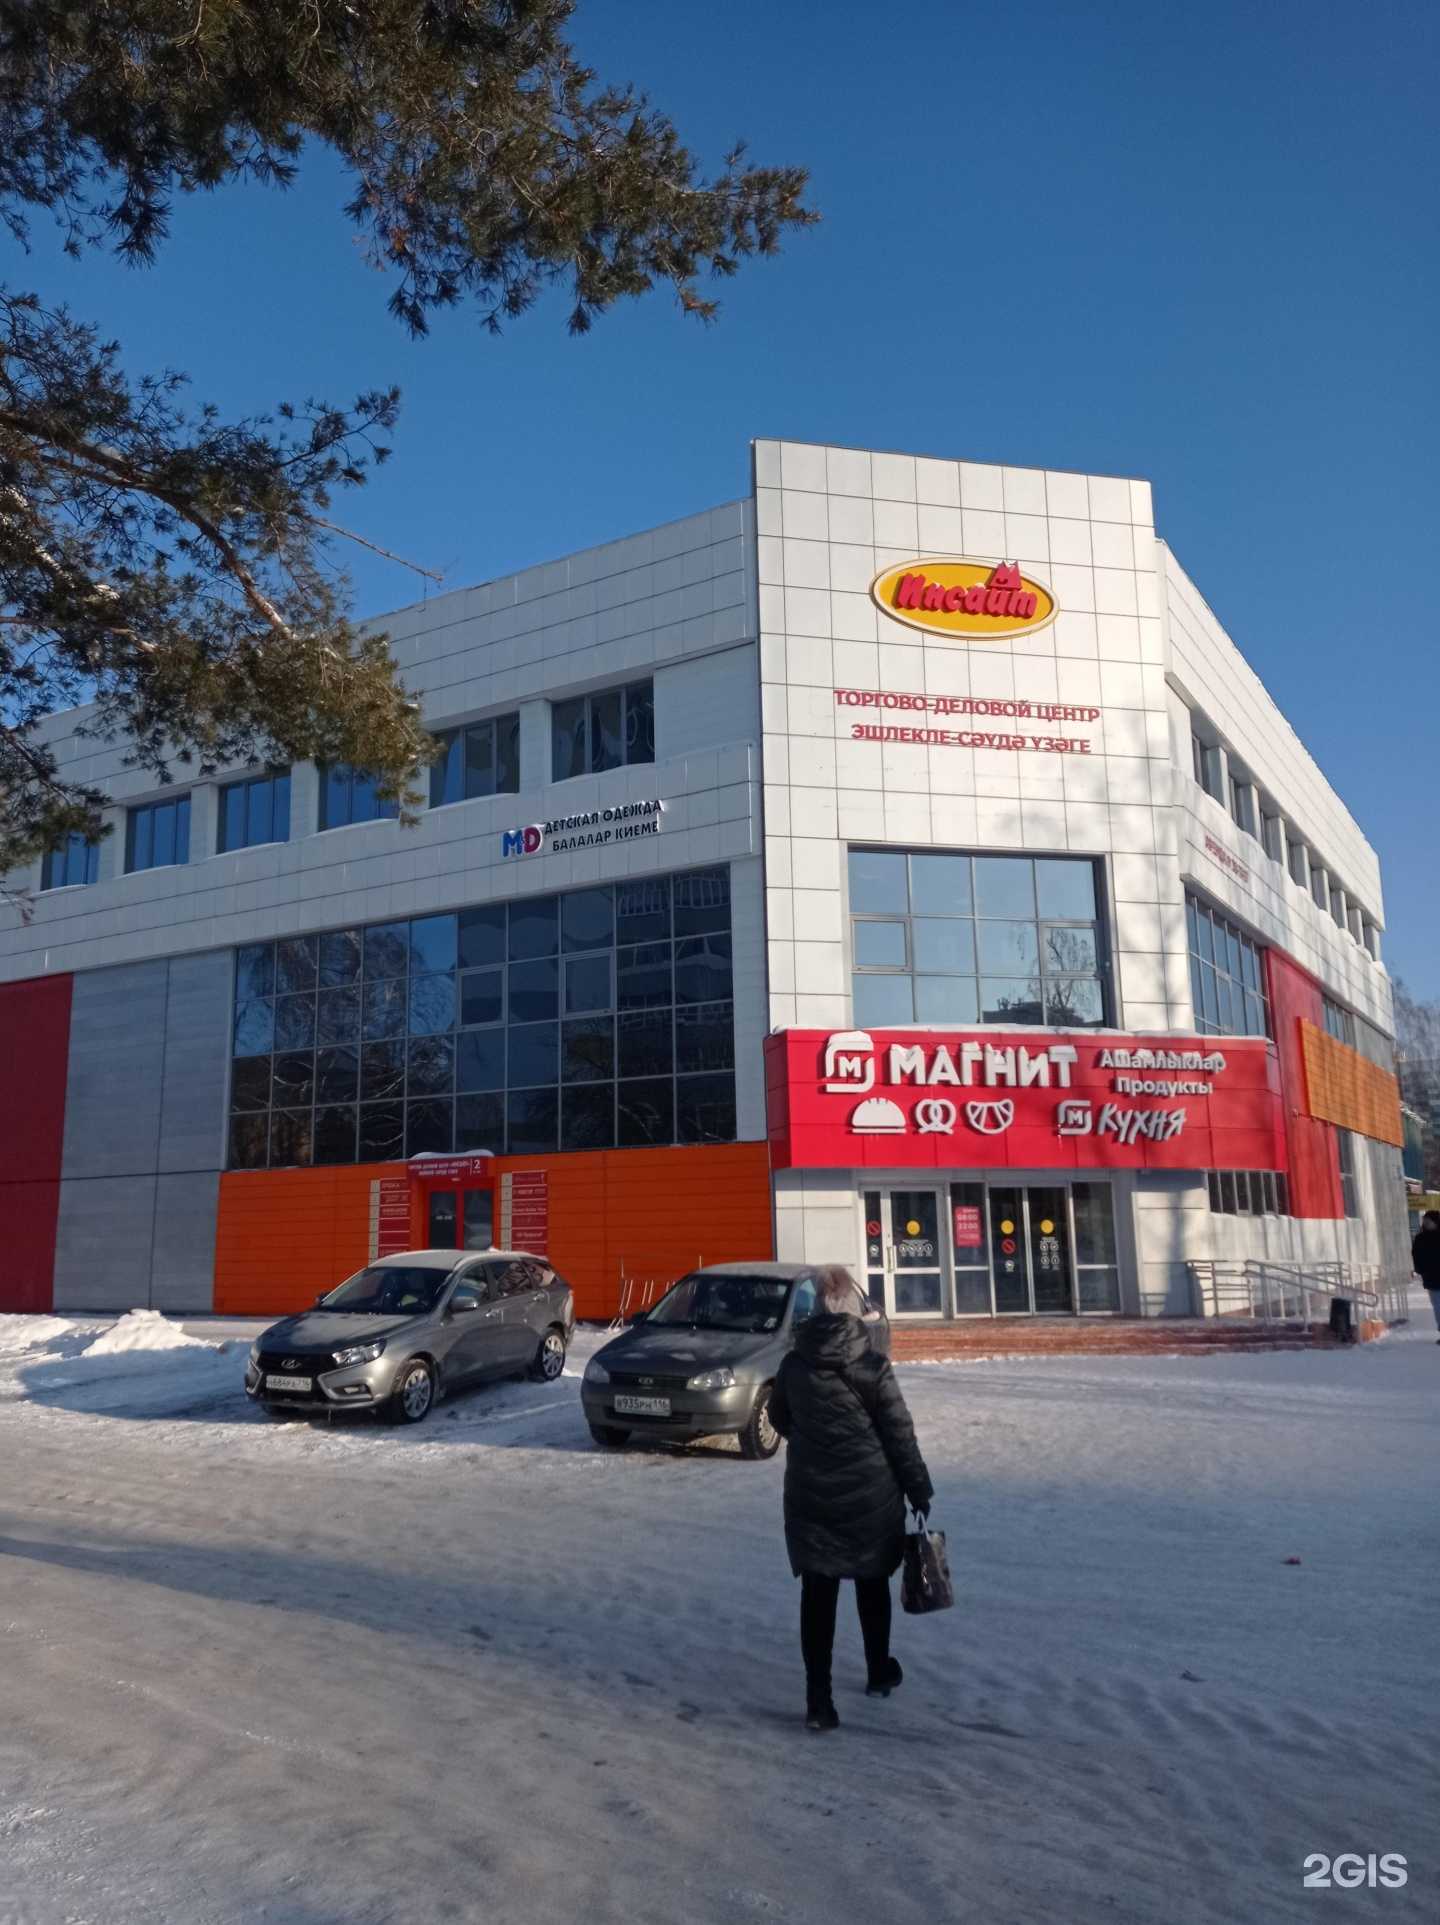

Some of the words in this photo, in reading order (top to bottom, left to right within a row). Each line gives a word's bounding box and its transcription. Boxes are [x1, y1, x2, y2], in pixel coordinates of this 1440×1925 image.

[832, 689, 1032, 718] ТОРГОВО-ДЕЛОВОЙ
[1036, 704, 1100, 722] ЦЕНТР
[544, 812, 598, 835] ДЕТСКАЯ
[603, 800, 662, 822] ОДЕЖДА
[552, 830, 612, 852] БАЛАЛАР
[615, 820, 659, 841] КИЕМЕ
[889, 1041, 1078, 1087] МАГНИТ
[1116, 1076, 1213, 1097] Продукты
